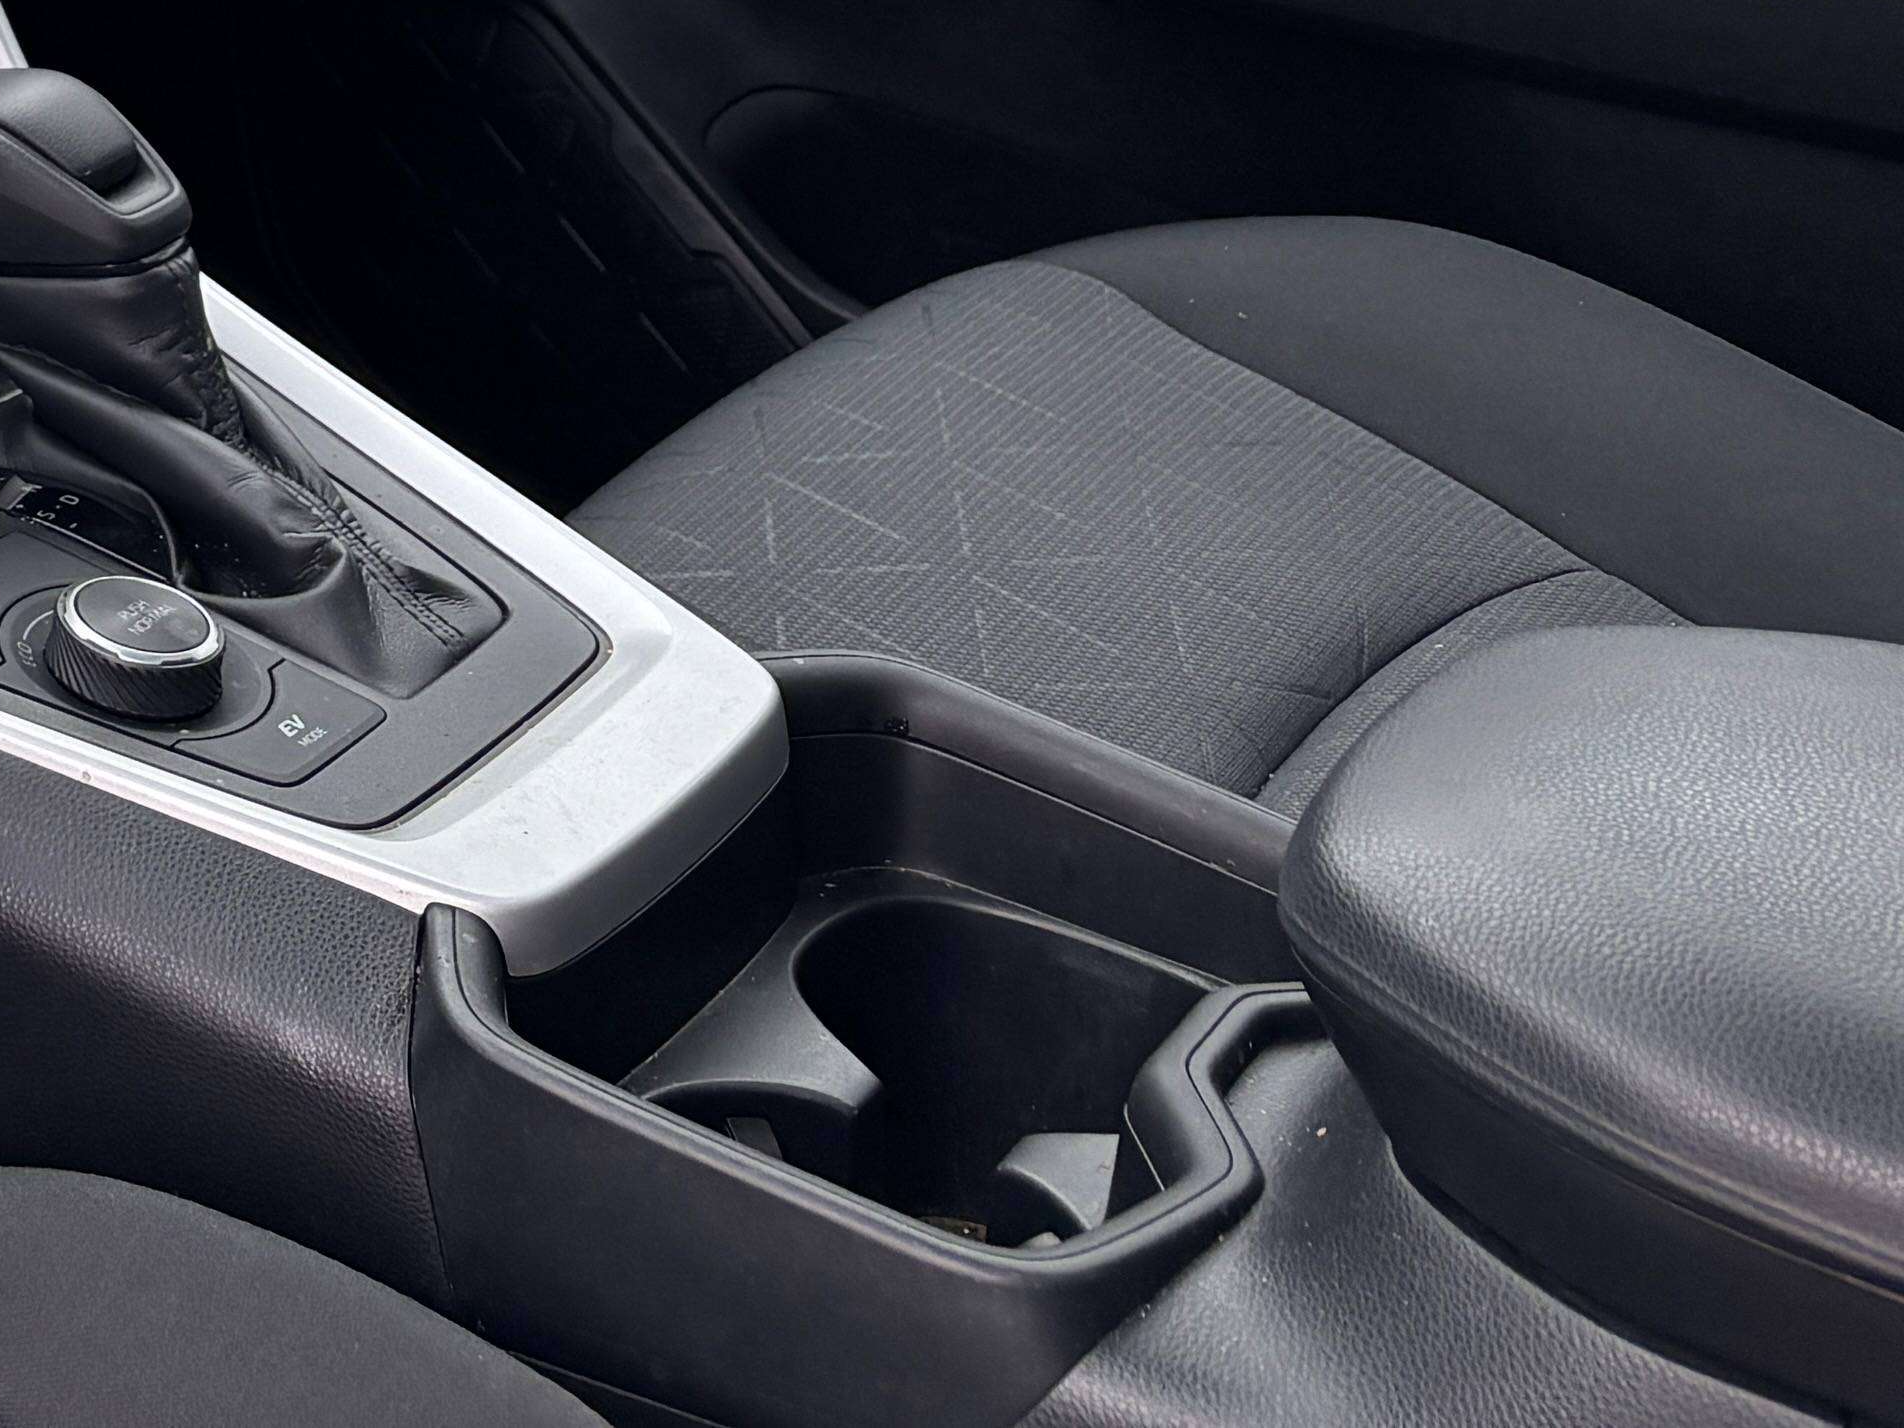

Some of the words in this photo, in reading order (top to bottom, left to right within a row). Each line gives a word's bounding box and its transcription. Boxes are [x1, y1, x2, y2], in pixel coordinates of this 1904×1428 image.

[59, 494, 80, 506] D
[117, 599, 151, 621] PUSH
[278, 713, 305, 737] EV
[297, 726, 329, 747] MODE
